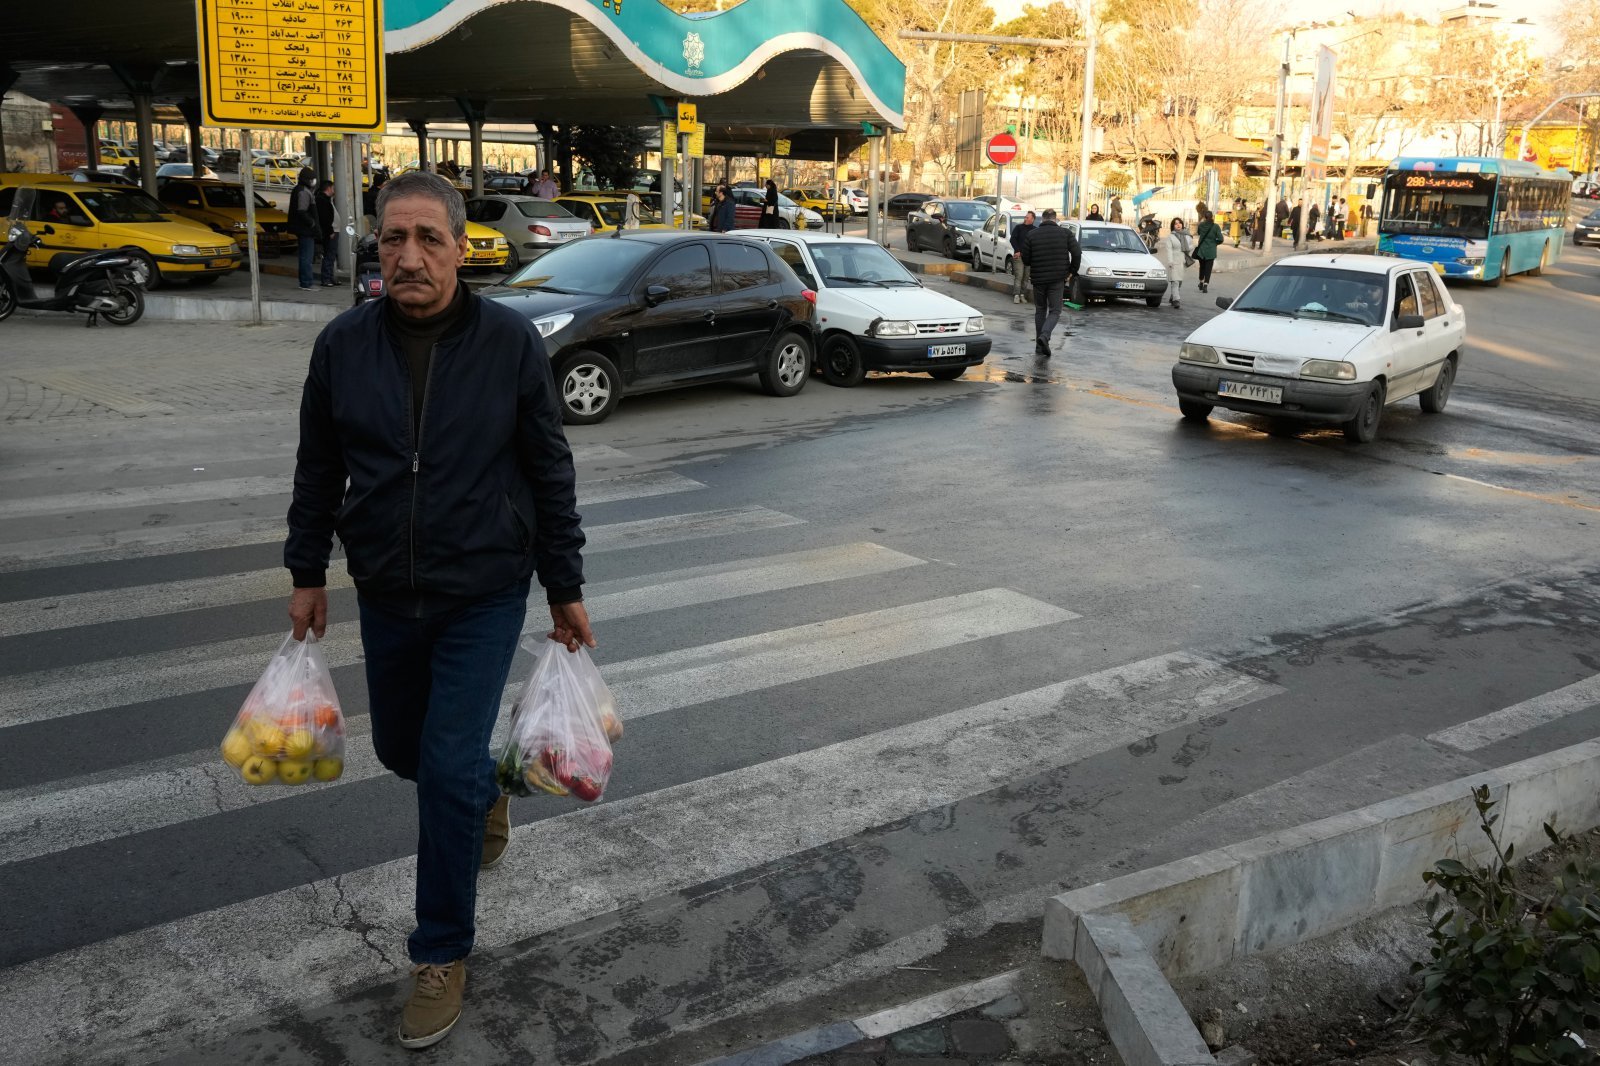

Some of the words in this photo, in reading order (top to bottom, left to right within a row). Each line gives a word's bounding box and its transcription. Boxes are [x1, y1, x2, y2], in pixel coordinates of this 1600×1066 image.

[272, 0, 295, 8] انقلاب
[298, 1, 320, 11] میدان
[333, 3, 352, 13] ۶۴۸
[231, 11, 254, 20] ۱۹۰۰۰
[282, 14, 307, 25] صادقیه
[233, 26, 255, 35] ۲۸۰۰
[305, 31, 324, 39] آصف
[337, 32, 352, 41] ۱۱۶
[234, 40, 254, 49] ۵۰۰۰
[284, 43, 310, 54] ولنجک
[337, 47, 352, 56] ۱۱۵
[287, 56, 307, 67] پونک
[276, 69, 297, 77] صنعت
[298, 70, 320, 79] میدان
[235, 79, 259, 88] ۱۴۰۰۰
[234, 91, 260, 101] ۵۴۰۰۰
[292, 94, 308, 104] کرج
[679, 111, 695, 125] پونک
